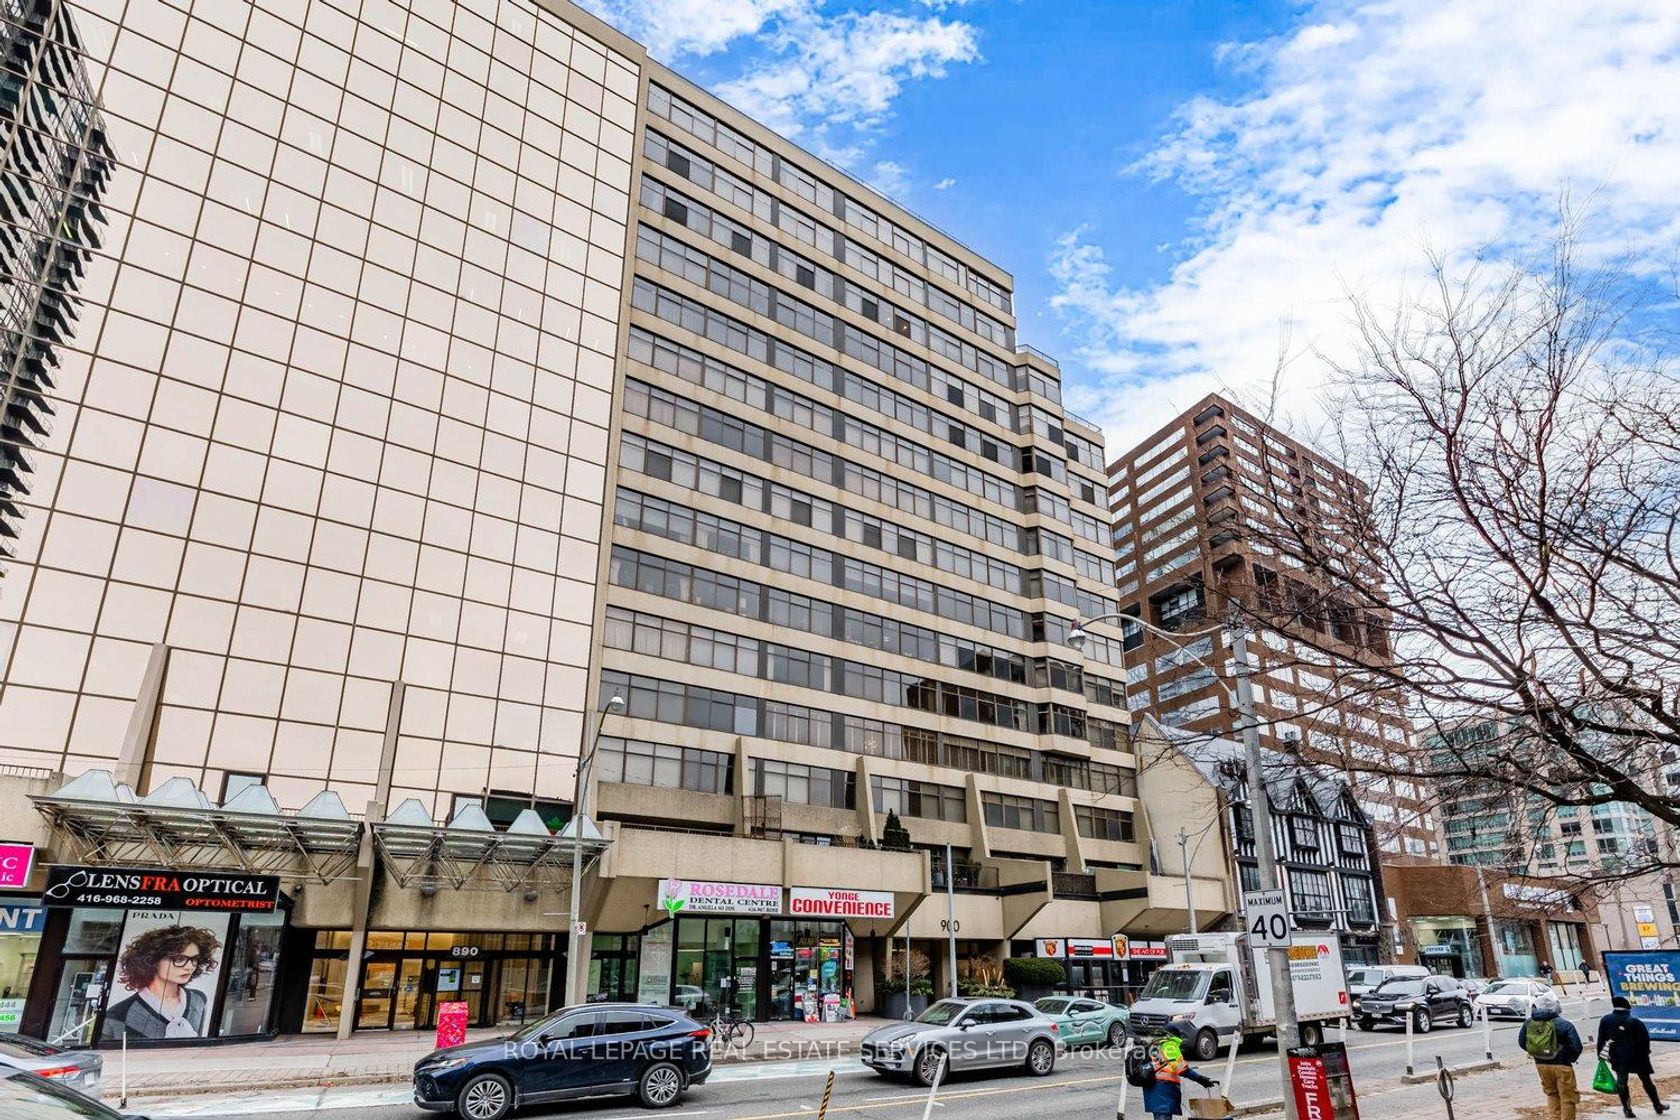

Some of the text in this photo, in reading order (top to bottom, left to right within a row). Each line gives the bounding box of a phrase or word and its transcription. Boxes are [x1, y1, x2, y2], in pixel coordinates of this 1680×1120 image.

[183, 878, 267, 894] OPTICAL
[690, 882, 780, 900] ROSEDALE
[77, 894, 162, 906] 416-968-2258
[690, 896, 734, 905] DENTAL
[828, 891, 860, 900] YONGE
[185, 898, 275, 909] OPTOMETRIST
[1248, 896, 1282, 906] MAXIMUM
[792, 898, 892, 916] CONVENIENCE
[132, 911, 176, 920] PRADA
[1251, 914, 1287, 940] 40
[452, 946, 478, 956] 890
[1625, 964, 1668, 974] GREAT
[1623, 973, 1676, 982] THINGS
[1620, 982, 1680, 991] BREWING
